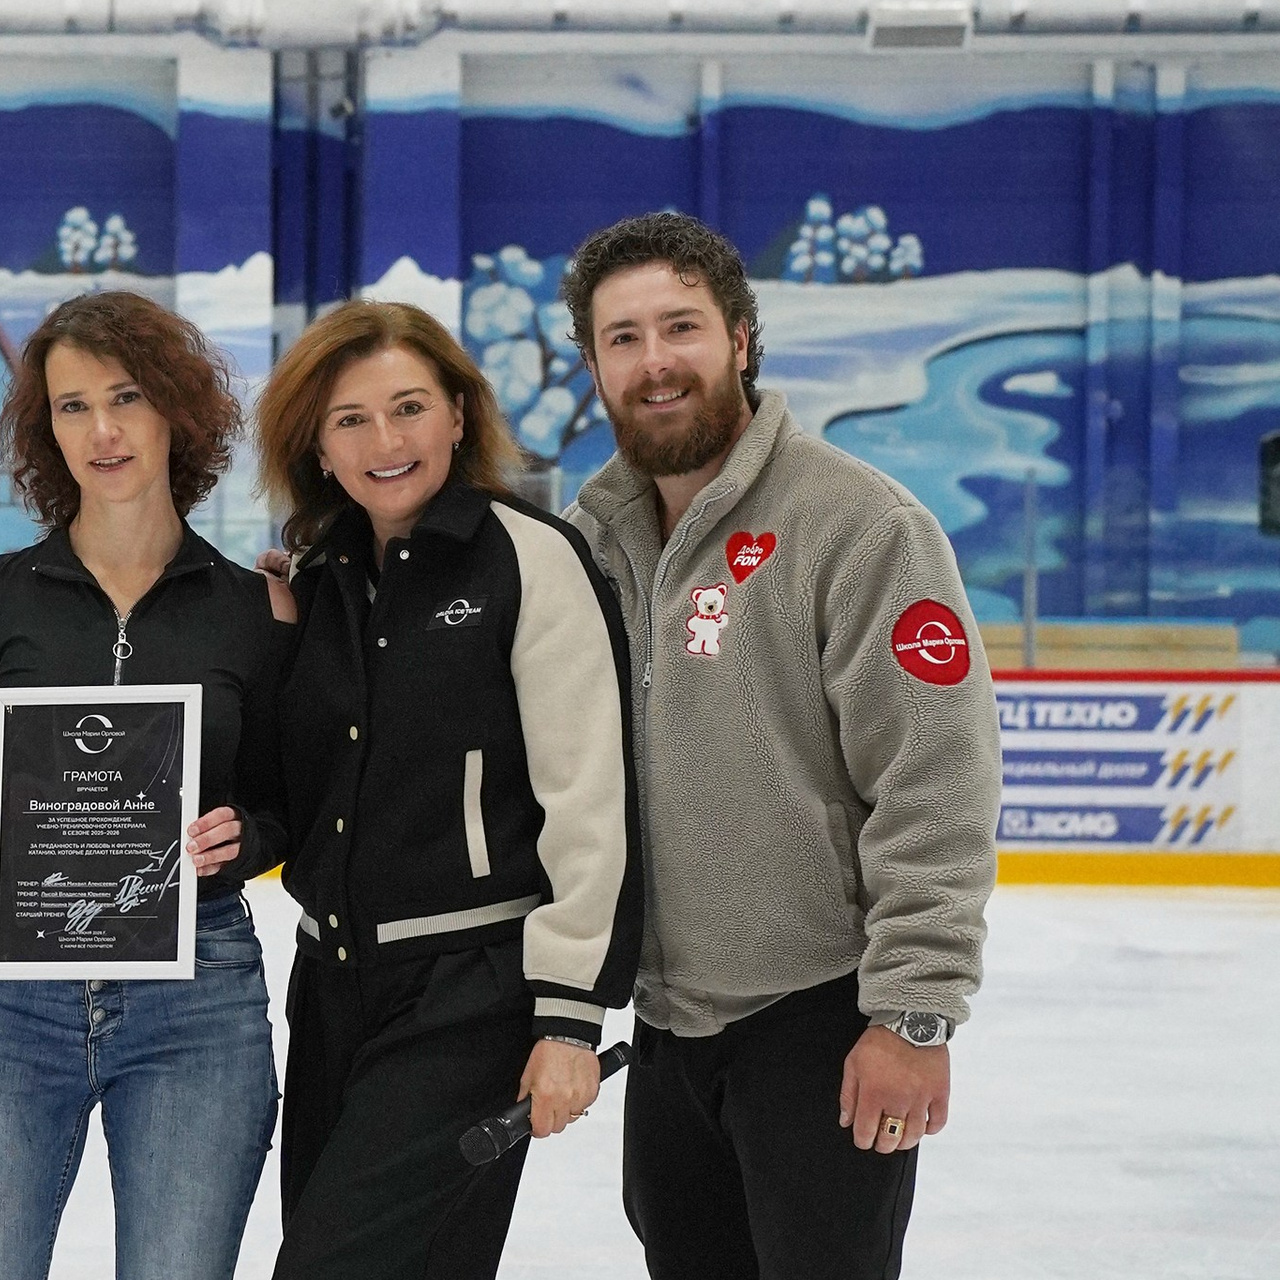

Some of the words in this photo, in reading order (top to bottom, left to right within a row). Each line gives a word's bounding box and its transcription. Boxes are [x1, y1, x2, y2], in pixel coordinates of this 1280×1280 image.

[737, 542, 764, 555] Добро
[733, 555, 761, 566] FON
[895, 642, 922, 652] Школа
[922, 639, 944, 648] Марии
[1033, 701, 1139, 728] ТЕХНО
[63, 770, 123, 782] ГРАМОТА
[29, 799, 120, 813] Виноградовой
[123, 799, 155, 810] Анне
